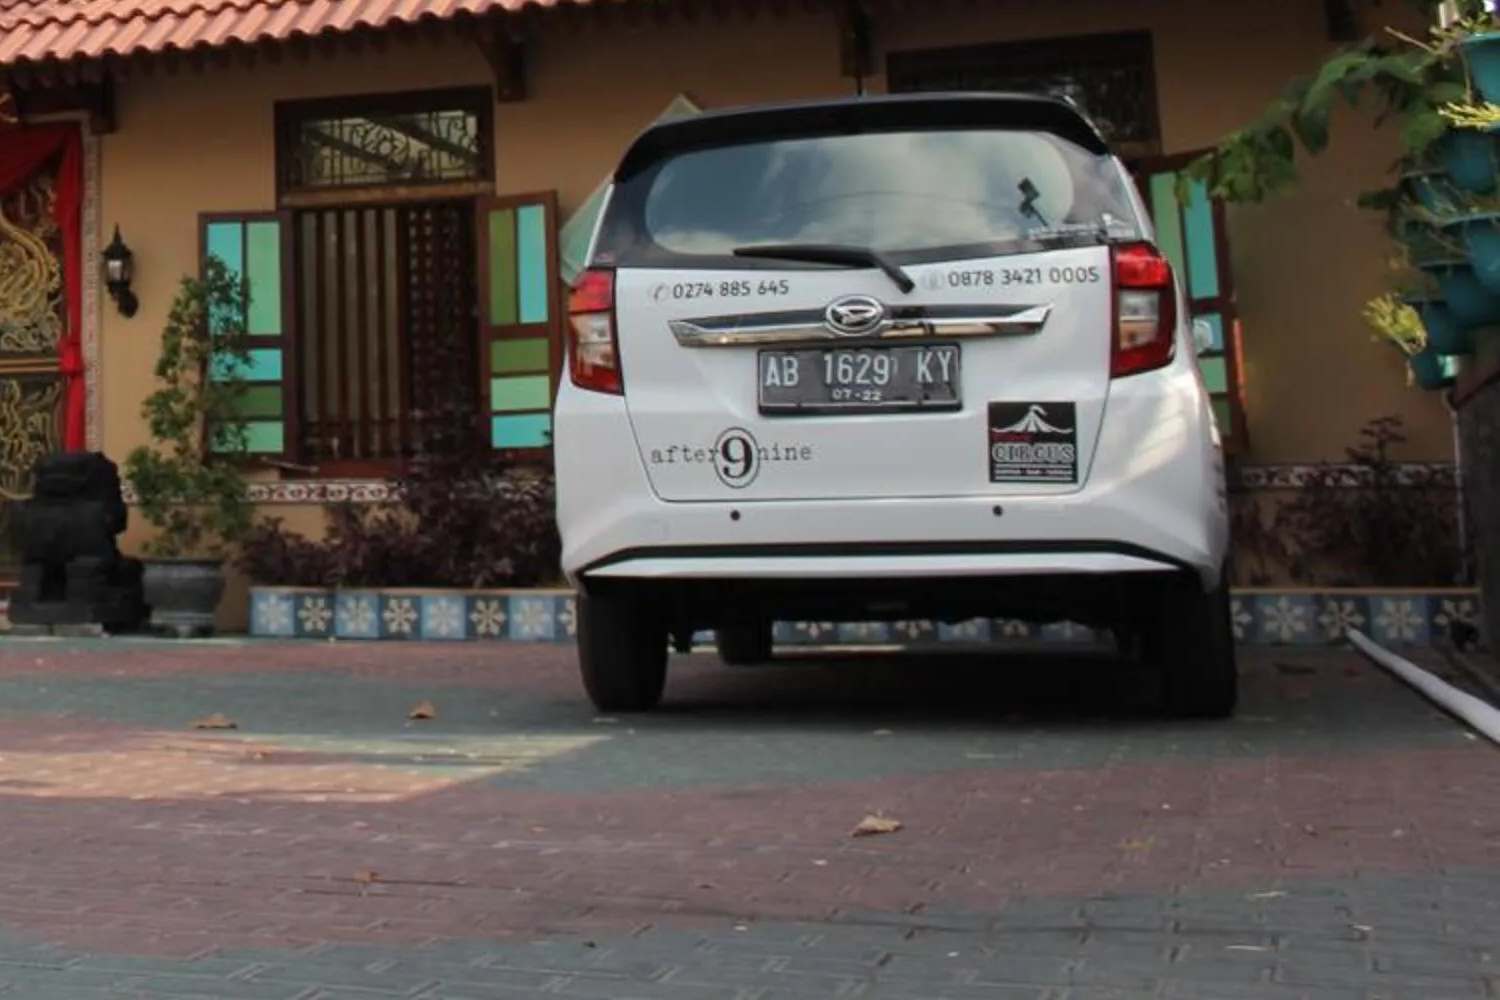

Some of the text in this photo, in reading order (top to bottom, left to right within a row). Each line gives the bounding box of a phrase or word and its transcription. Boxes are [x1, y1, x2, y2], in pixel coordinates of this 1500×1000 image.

[947, 266, 1100, 287] 0878 3421 0005
[672, 280, 790, 299] 0274 885 645
[764, 350, 953, 387] AB 1629 KY
[651, 445, 718, 464] after
[757, 443, 813, 461] nine
[991, 442, 1076, 463] CIRCUS
